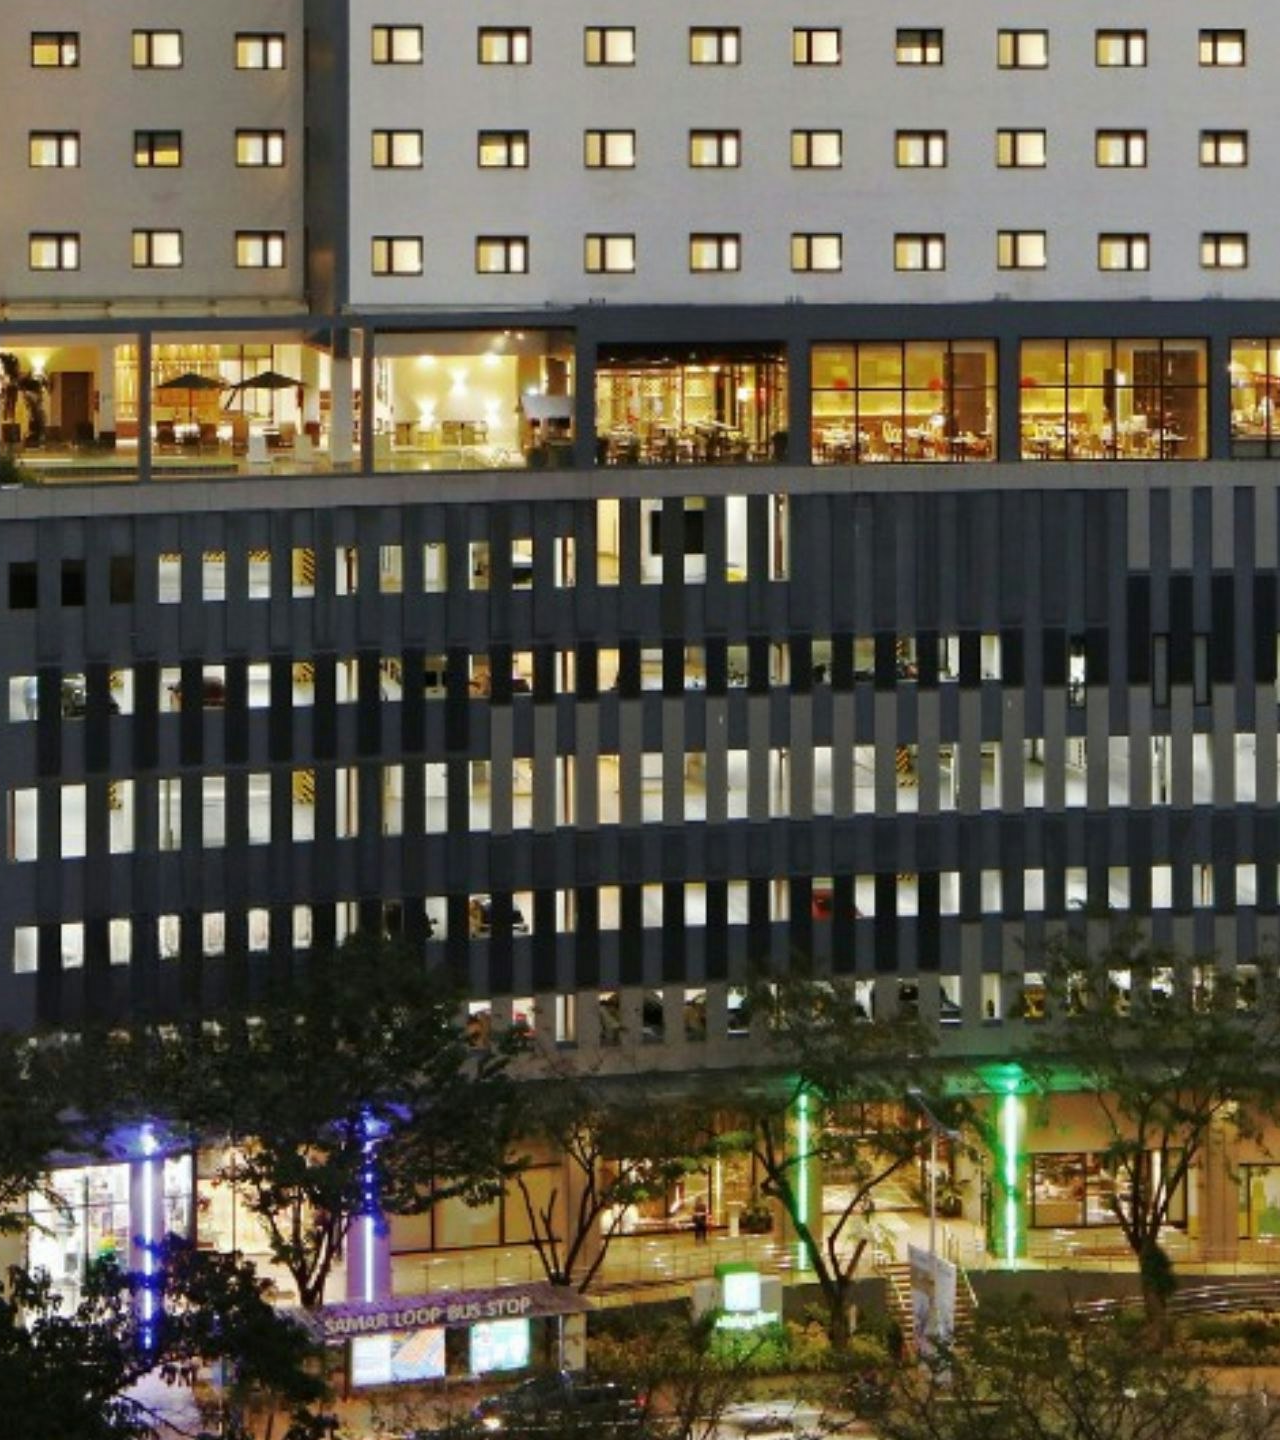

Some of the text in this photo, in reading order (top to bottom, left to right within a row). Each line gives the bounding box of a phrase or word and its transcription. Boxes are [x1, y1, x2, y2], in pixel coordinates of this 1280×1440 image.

[325, 1296, 531, 1335] SAMAR LOOP BUS STOP
